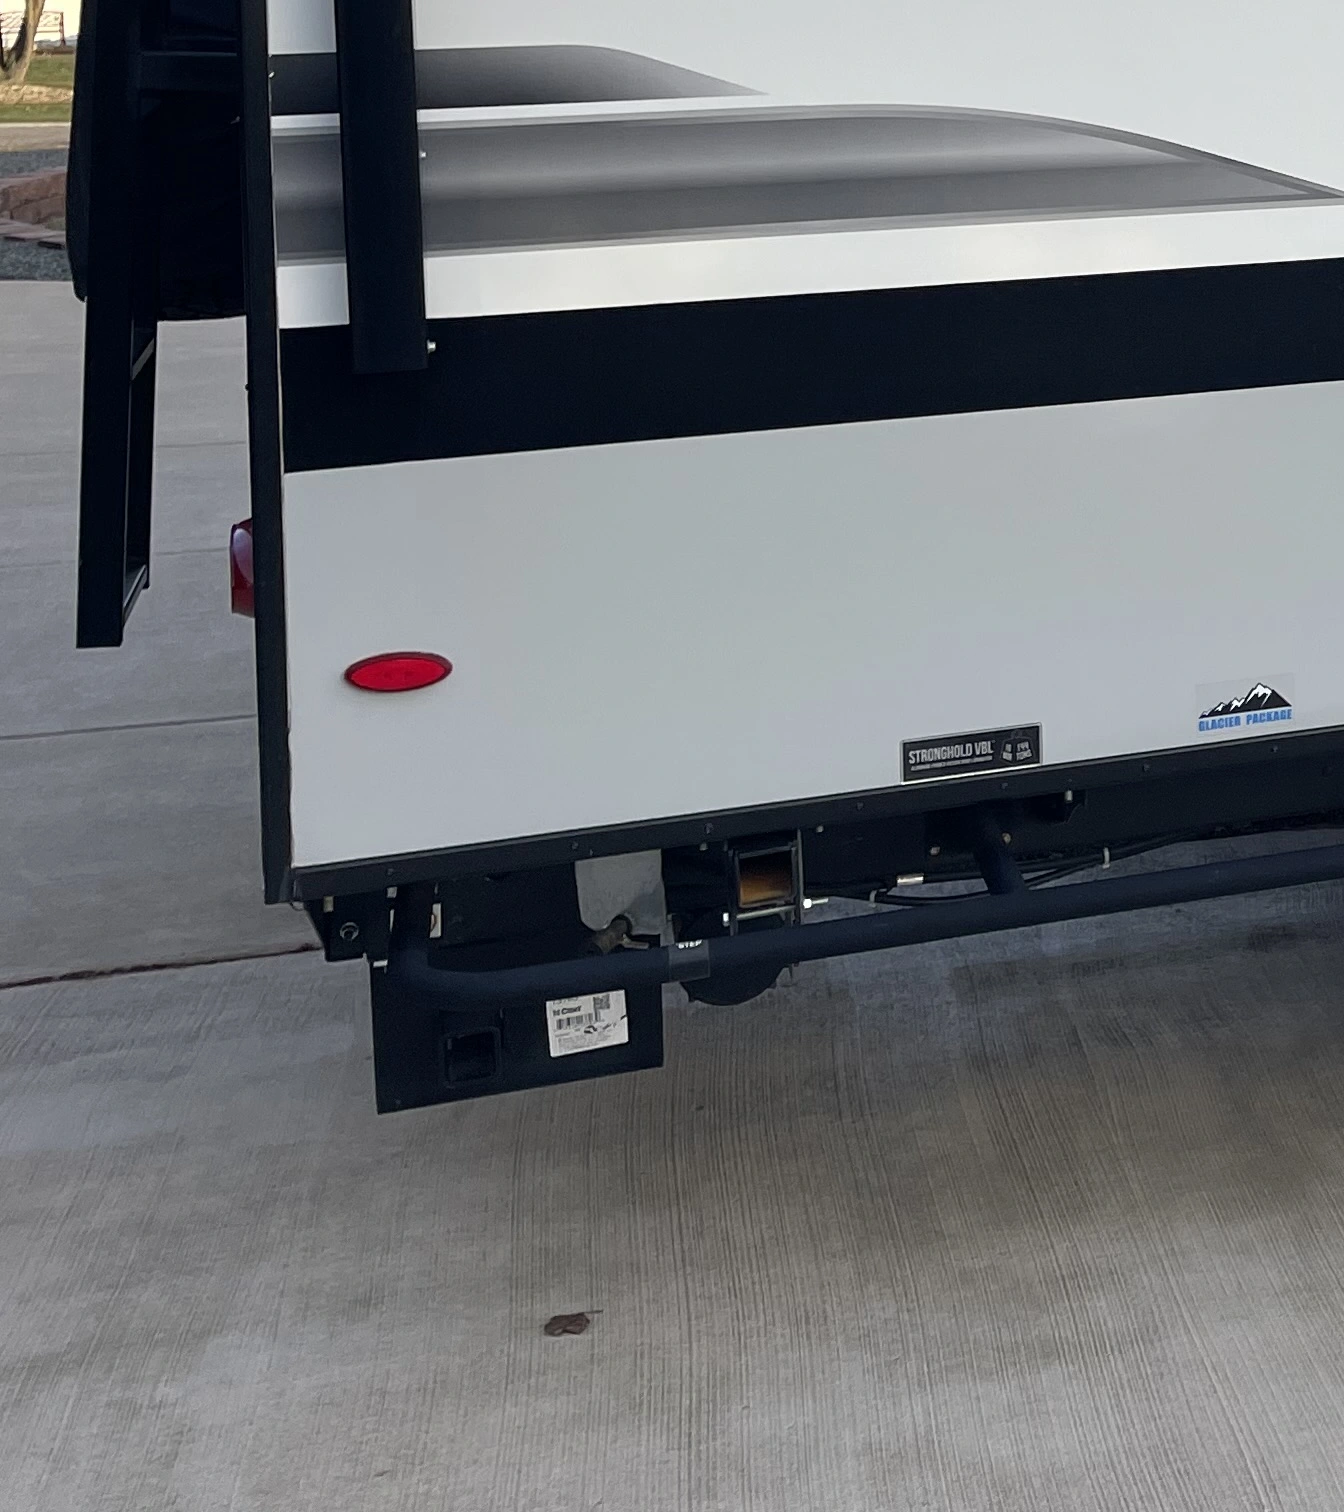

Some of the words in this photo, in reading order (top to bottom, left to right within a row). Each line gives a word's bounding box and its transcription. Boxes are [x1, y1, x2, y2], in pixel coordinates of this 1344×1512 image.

[1199, 716, 1241, 731] GLACIER
[1246, 709, 1292, 725] PACKAGE
[908, 743, 972, 764] STRONGHOLD
